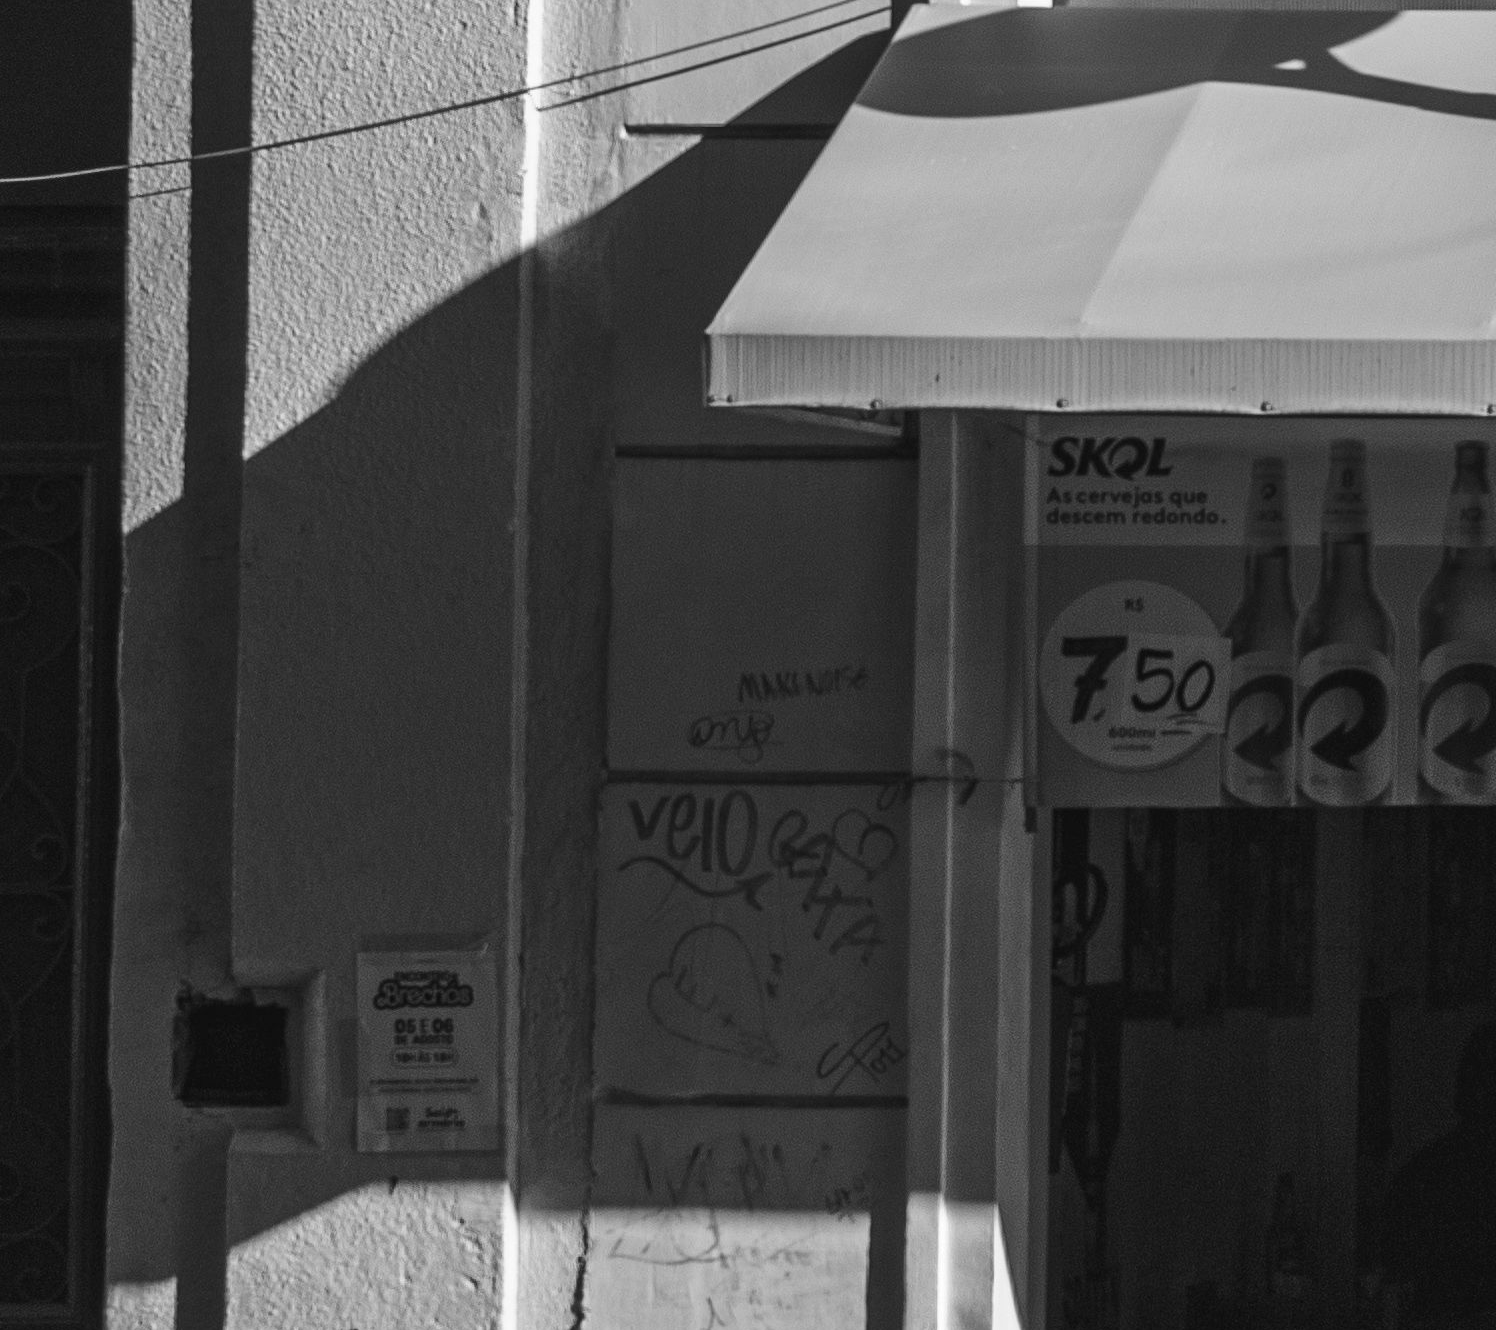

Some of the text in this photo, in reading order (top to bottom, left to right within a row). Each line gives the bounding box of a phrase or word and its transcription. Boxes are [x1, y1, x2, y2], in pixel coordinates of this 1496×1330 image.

[1046, 435, 1175, 482] SKOL
[1045, 485, 1208, 508] As cervejas que
[1045, 507, 1228, 526] descem redondo.
